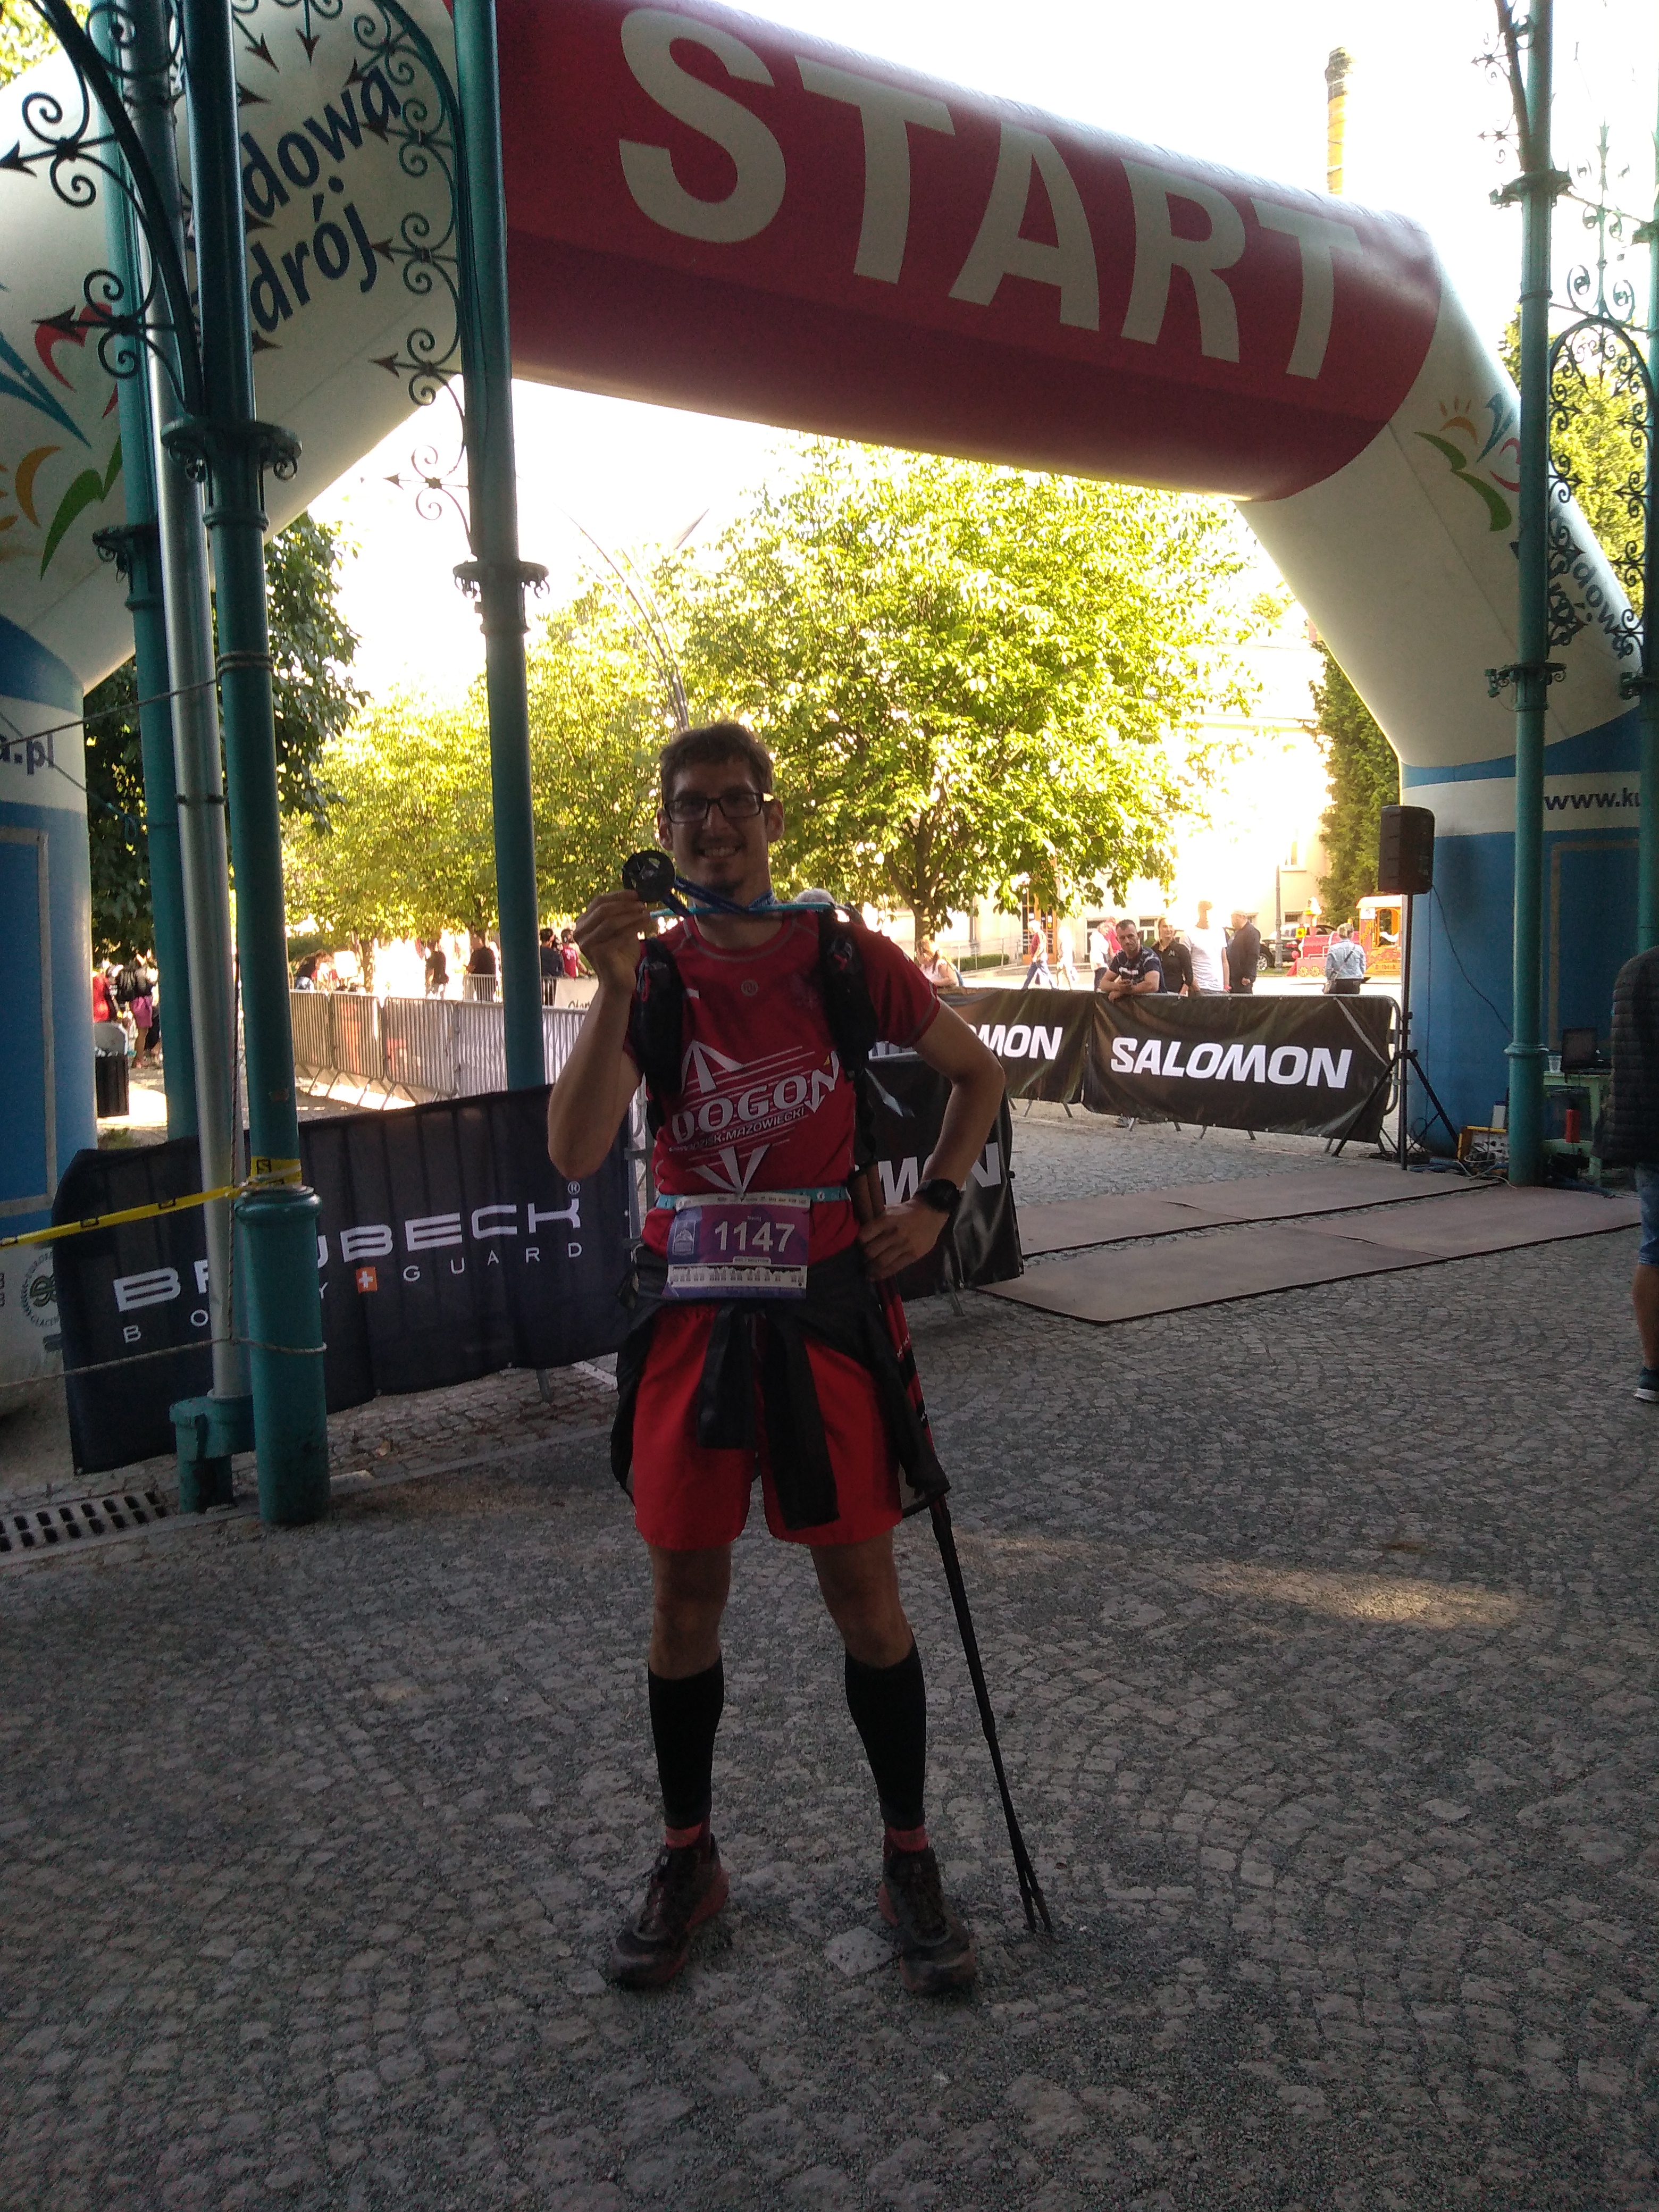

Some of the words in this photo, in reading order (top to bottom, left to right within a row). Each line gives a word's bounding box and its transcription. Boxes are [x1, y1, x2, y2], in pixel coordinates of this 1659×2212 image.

[618, 9, 1362, 380] START
[968, 1024, 1063, 1060] MON
[1111, 1037, 1352, 1089] SALOMON
[113, 1197, 581, 1312] BBECK
[715, 1220, 795, 1252] 1147
[123, 1281, 329, 1344] BOY
[403, 1242, 583, 1282] GUARD
